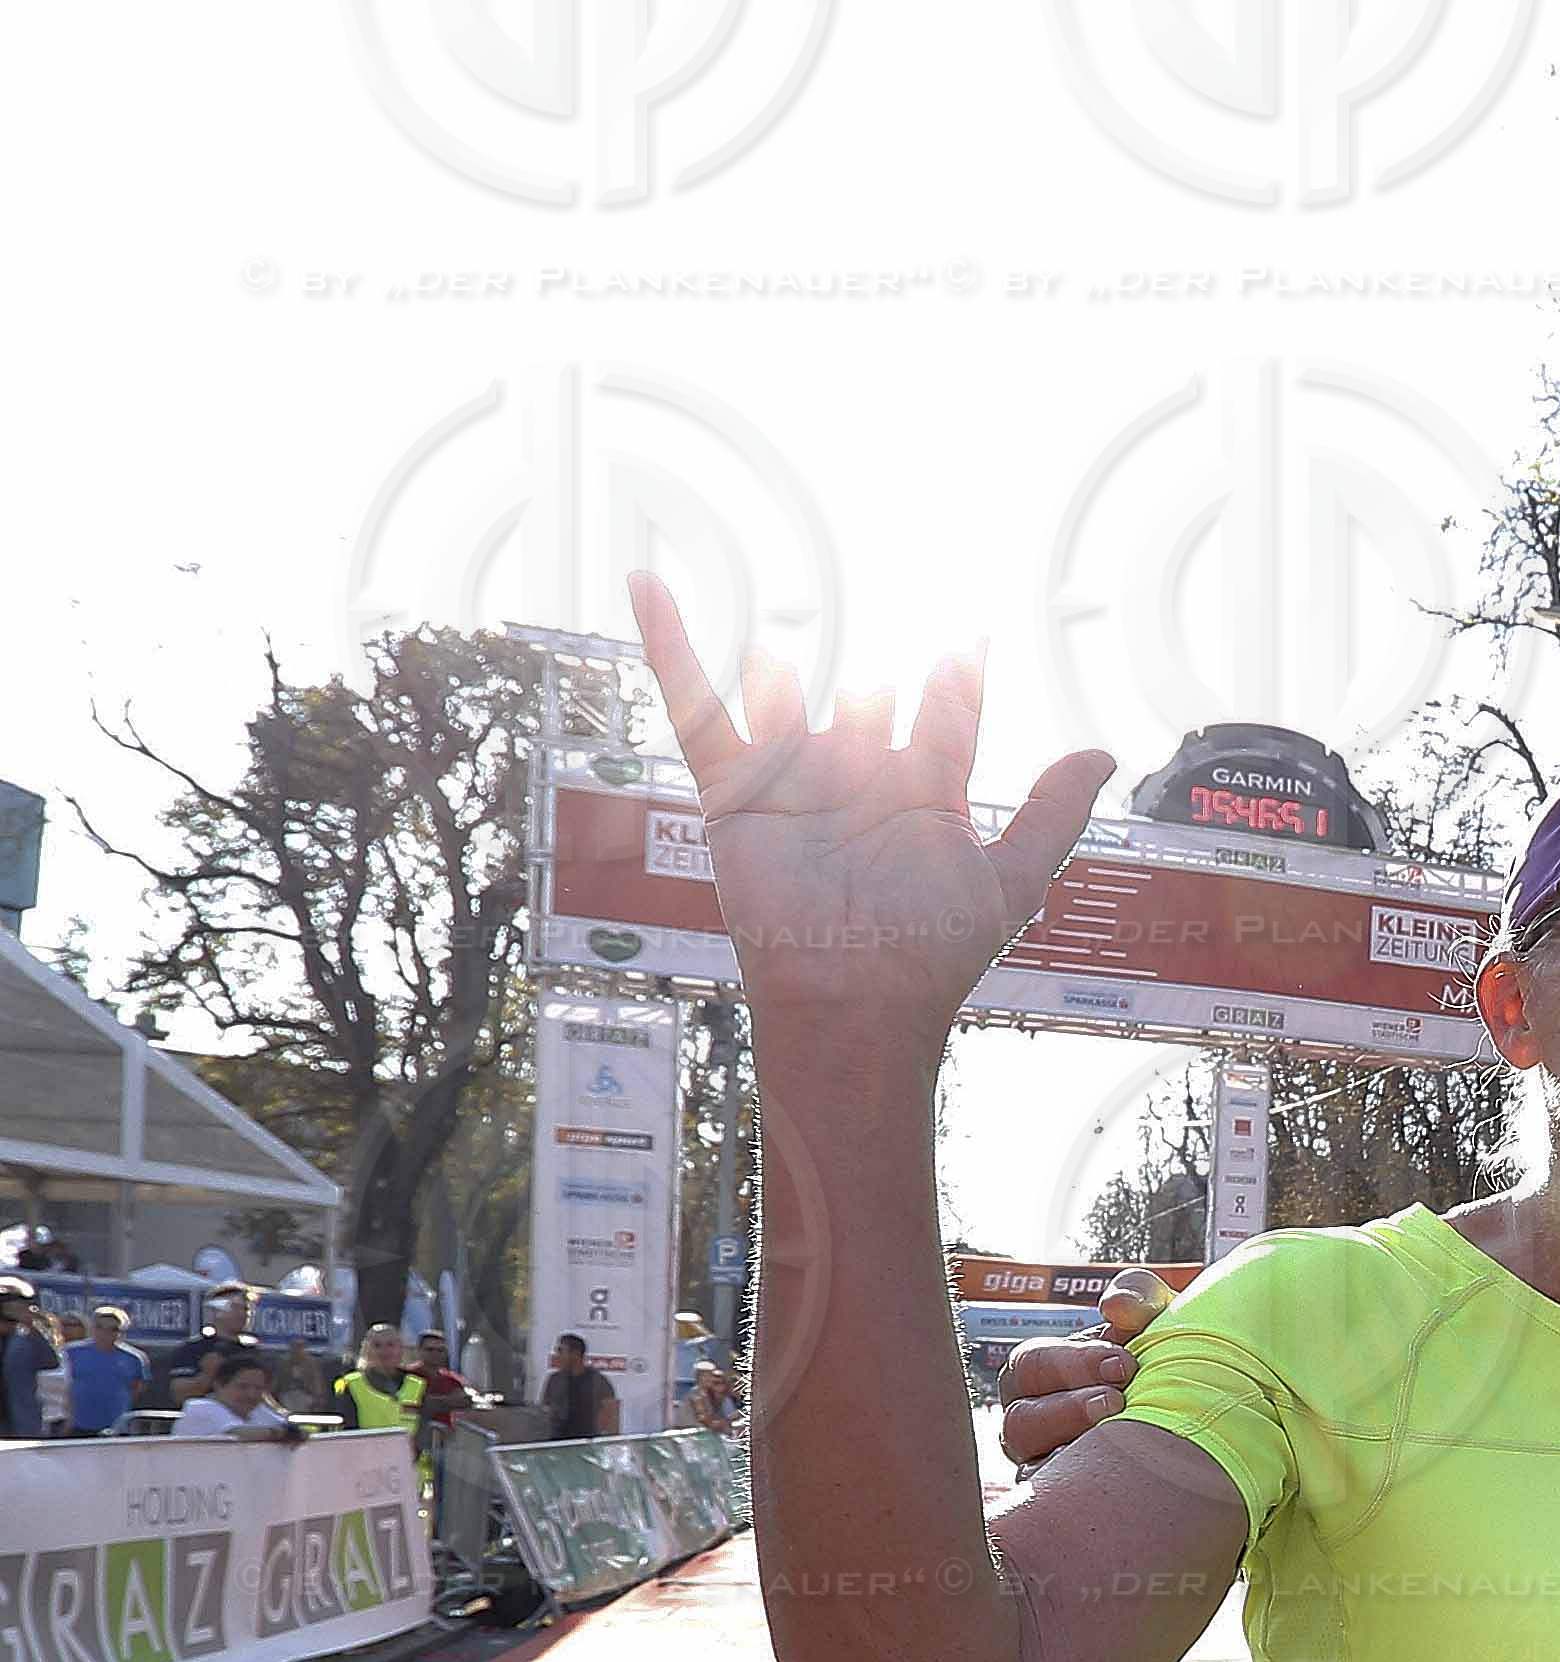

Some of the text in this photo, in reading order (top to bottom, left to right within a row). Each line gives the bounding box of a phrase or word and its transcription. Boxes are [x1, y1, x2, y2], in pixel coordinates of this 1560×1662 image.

[1212, 767, 1312, 796] GARMIN
[1214, 1006, 1284, 1030] GRAZ
[983, 1271, 1108, 1296] giga spo
[127, 1483, 232, 1526] HOLDING
[264, 1517, 409, 1623] GRAZ
